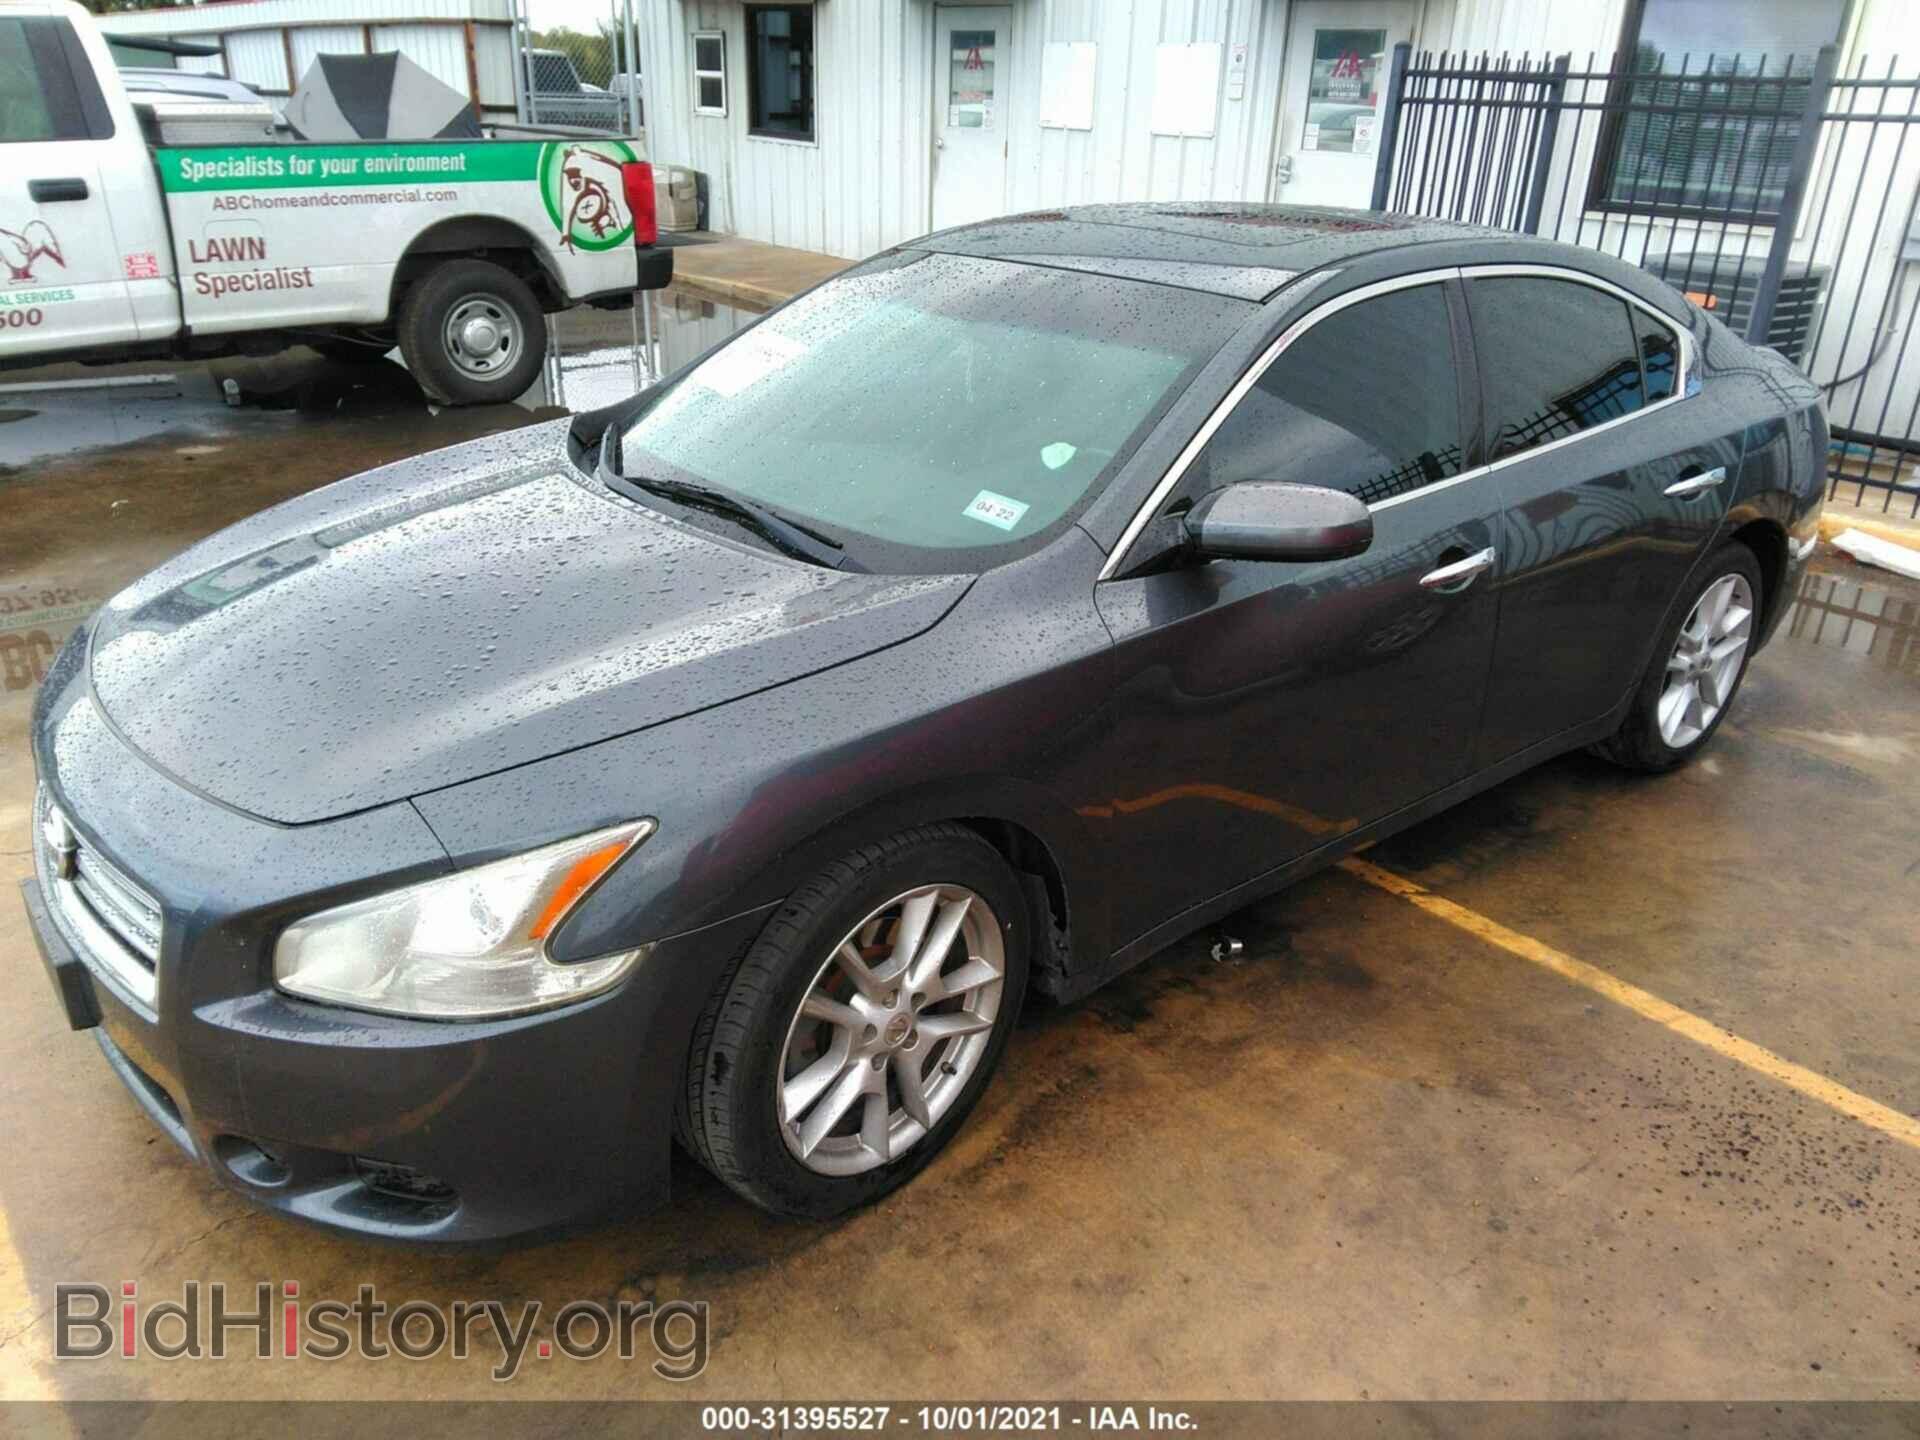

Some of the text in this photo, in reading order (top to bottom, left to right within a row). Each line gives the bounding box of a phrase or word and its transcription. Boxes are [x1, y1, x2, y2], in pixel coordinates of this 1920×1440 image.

[179, 152, 467, 181] Specialists for your environment
[212, 188, 458, 211] ABChomeandcommercial.com
[188, 236, 266, 263] LAWN
[193, 266, 314, 298] Specialist
[15, 288, 75, 305] SERVICES
